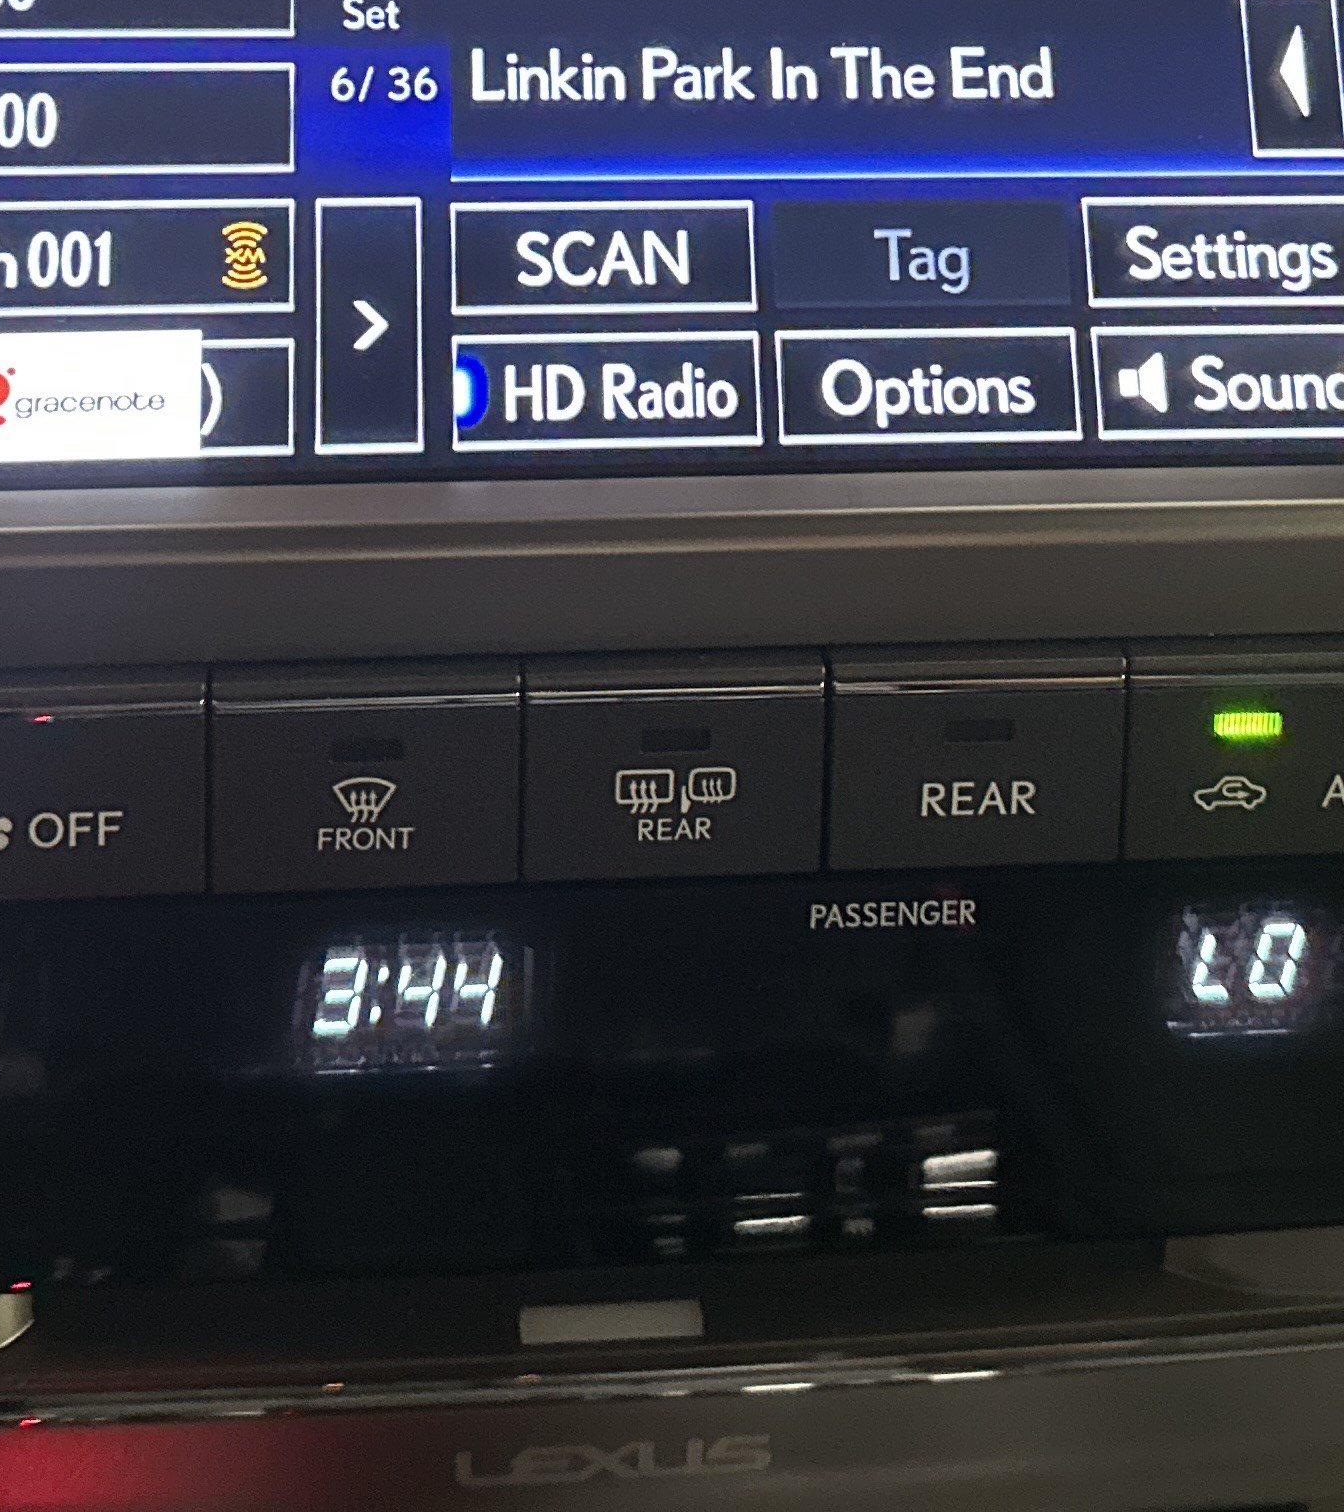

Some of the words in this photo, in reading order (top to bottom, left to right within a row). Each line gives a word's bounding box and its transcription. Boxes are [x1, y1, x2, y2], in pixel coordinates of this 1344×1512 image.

[470, 48, 626, 103] Linkin
[641, 48, 754, 102] Park
[771, 48, 818, 101] In
[831, 47, 935, 100] The
[952, 46, 1054, 100] End
[517, 230, 690, 286] SCAN
[873, 229, 971, 293] Tag
[1126, 225, 1338, 293] Settings
[14, 391, 166, 419] gracenote
[504, 363, 586, 422] HD
[601, 362, 739, 421] Radio
[821, 359, 1037, 428] Options
[919, 780, 1037, 818] REAR
[27, 810, 124, 850] OFF
[316, 826, 415, 852] FRONT
[636, 817, 712, 842] REAR
[809, 899, 977, 930] PASSENGER
[312, 952, 503, 1037] 3:44
[456, 1434, 773, 1487] LEXUS
